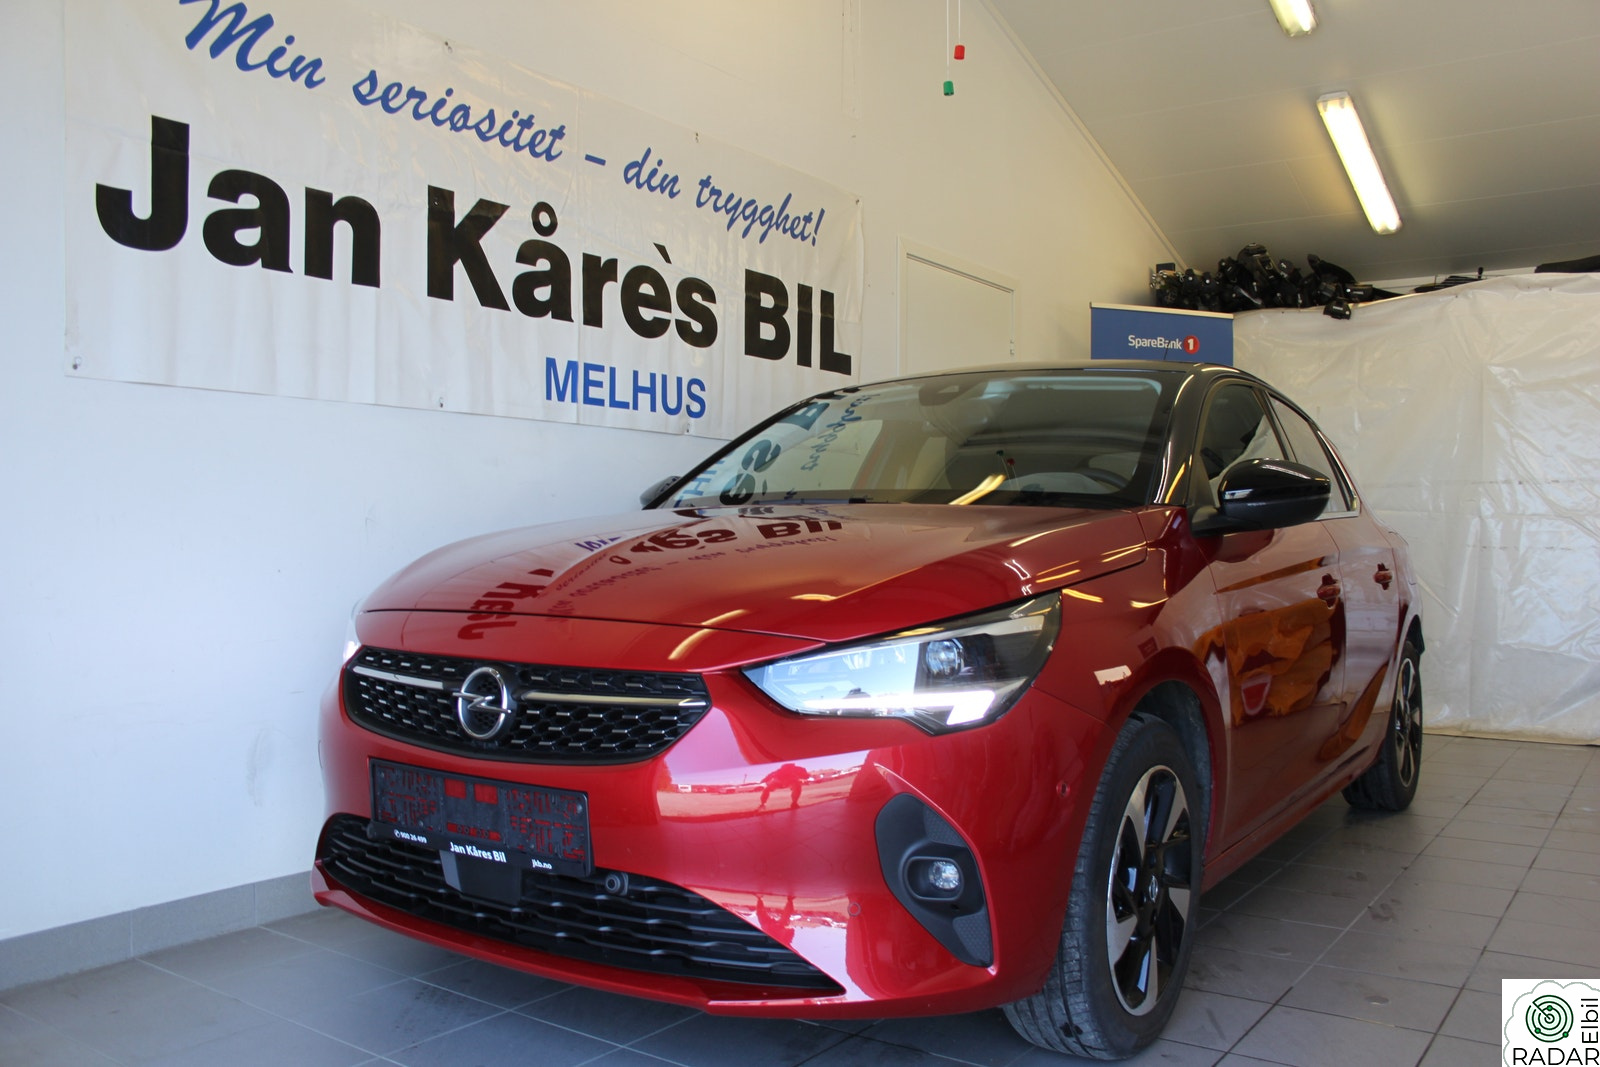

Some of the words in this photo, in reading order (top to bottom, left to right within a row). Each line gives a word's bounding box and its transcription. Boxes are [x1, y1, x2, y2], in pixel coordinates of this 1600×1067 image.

[179, 0, 326, 89] Min
[623, 146, 681, 199] din
[696, 173, 826, 247] trygghet!
[95, 114, 381, 289] Jan
[744, 268, 852, 376] BIL
[1128, 335, 1182, 349] SpareBank
[545, 356, 706, 419] MELHUS
[450, 841, 466, 854] Jan
[465, 844, 492, 860] Kåres
[492, 850, 507, 863] Bil
